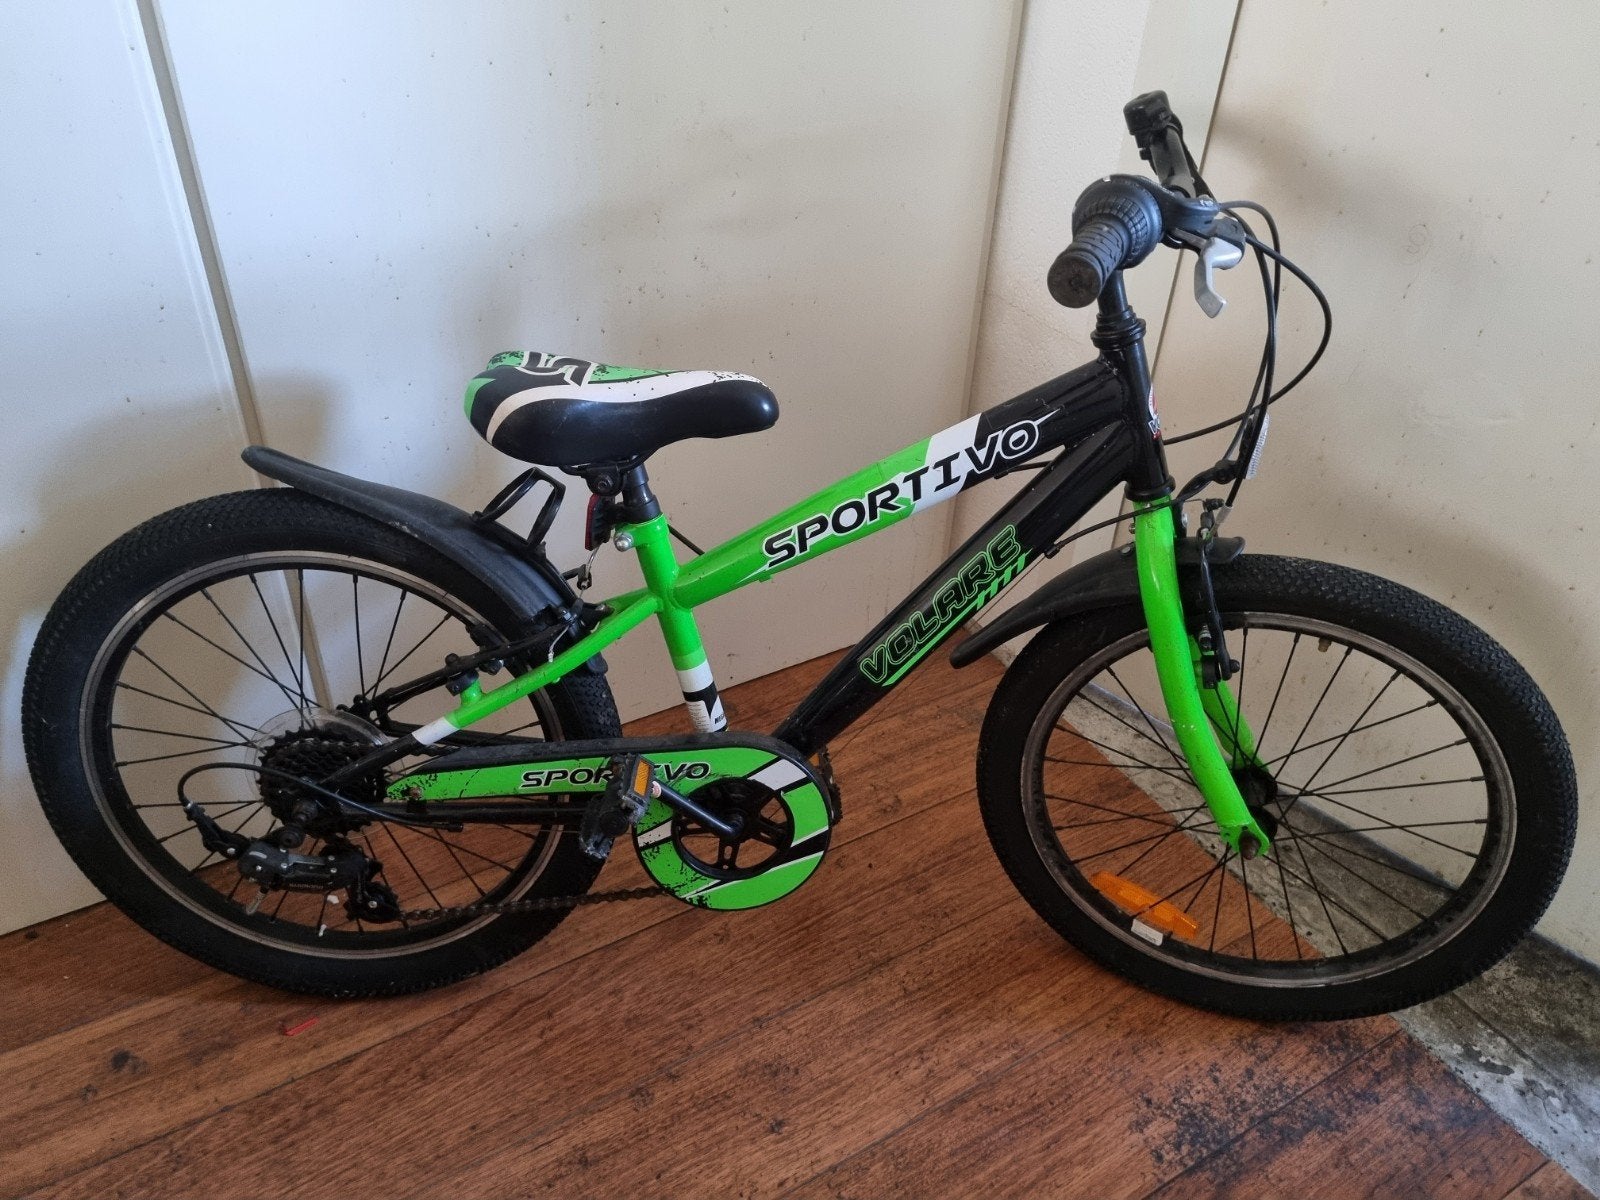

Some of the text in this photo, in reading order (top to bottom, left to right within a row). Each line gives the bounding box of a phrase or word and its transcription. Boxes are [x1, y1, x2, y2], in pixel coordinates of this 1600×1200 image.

[762, 420, 1040, 568] SPORTIVO
[859, 523, 1021, 684] VOLARE
[519, 761, 711, 789] SPORVO
